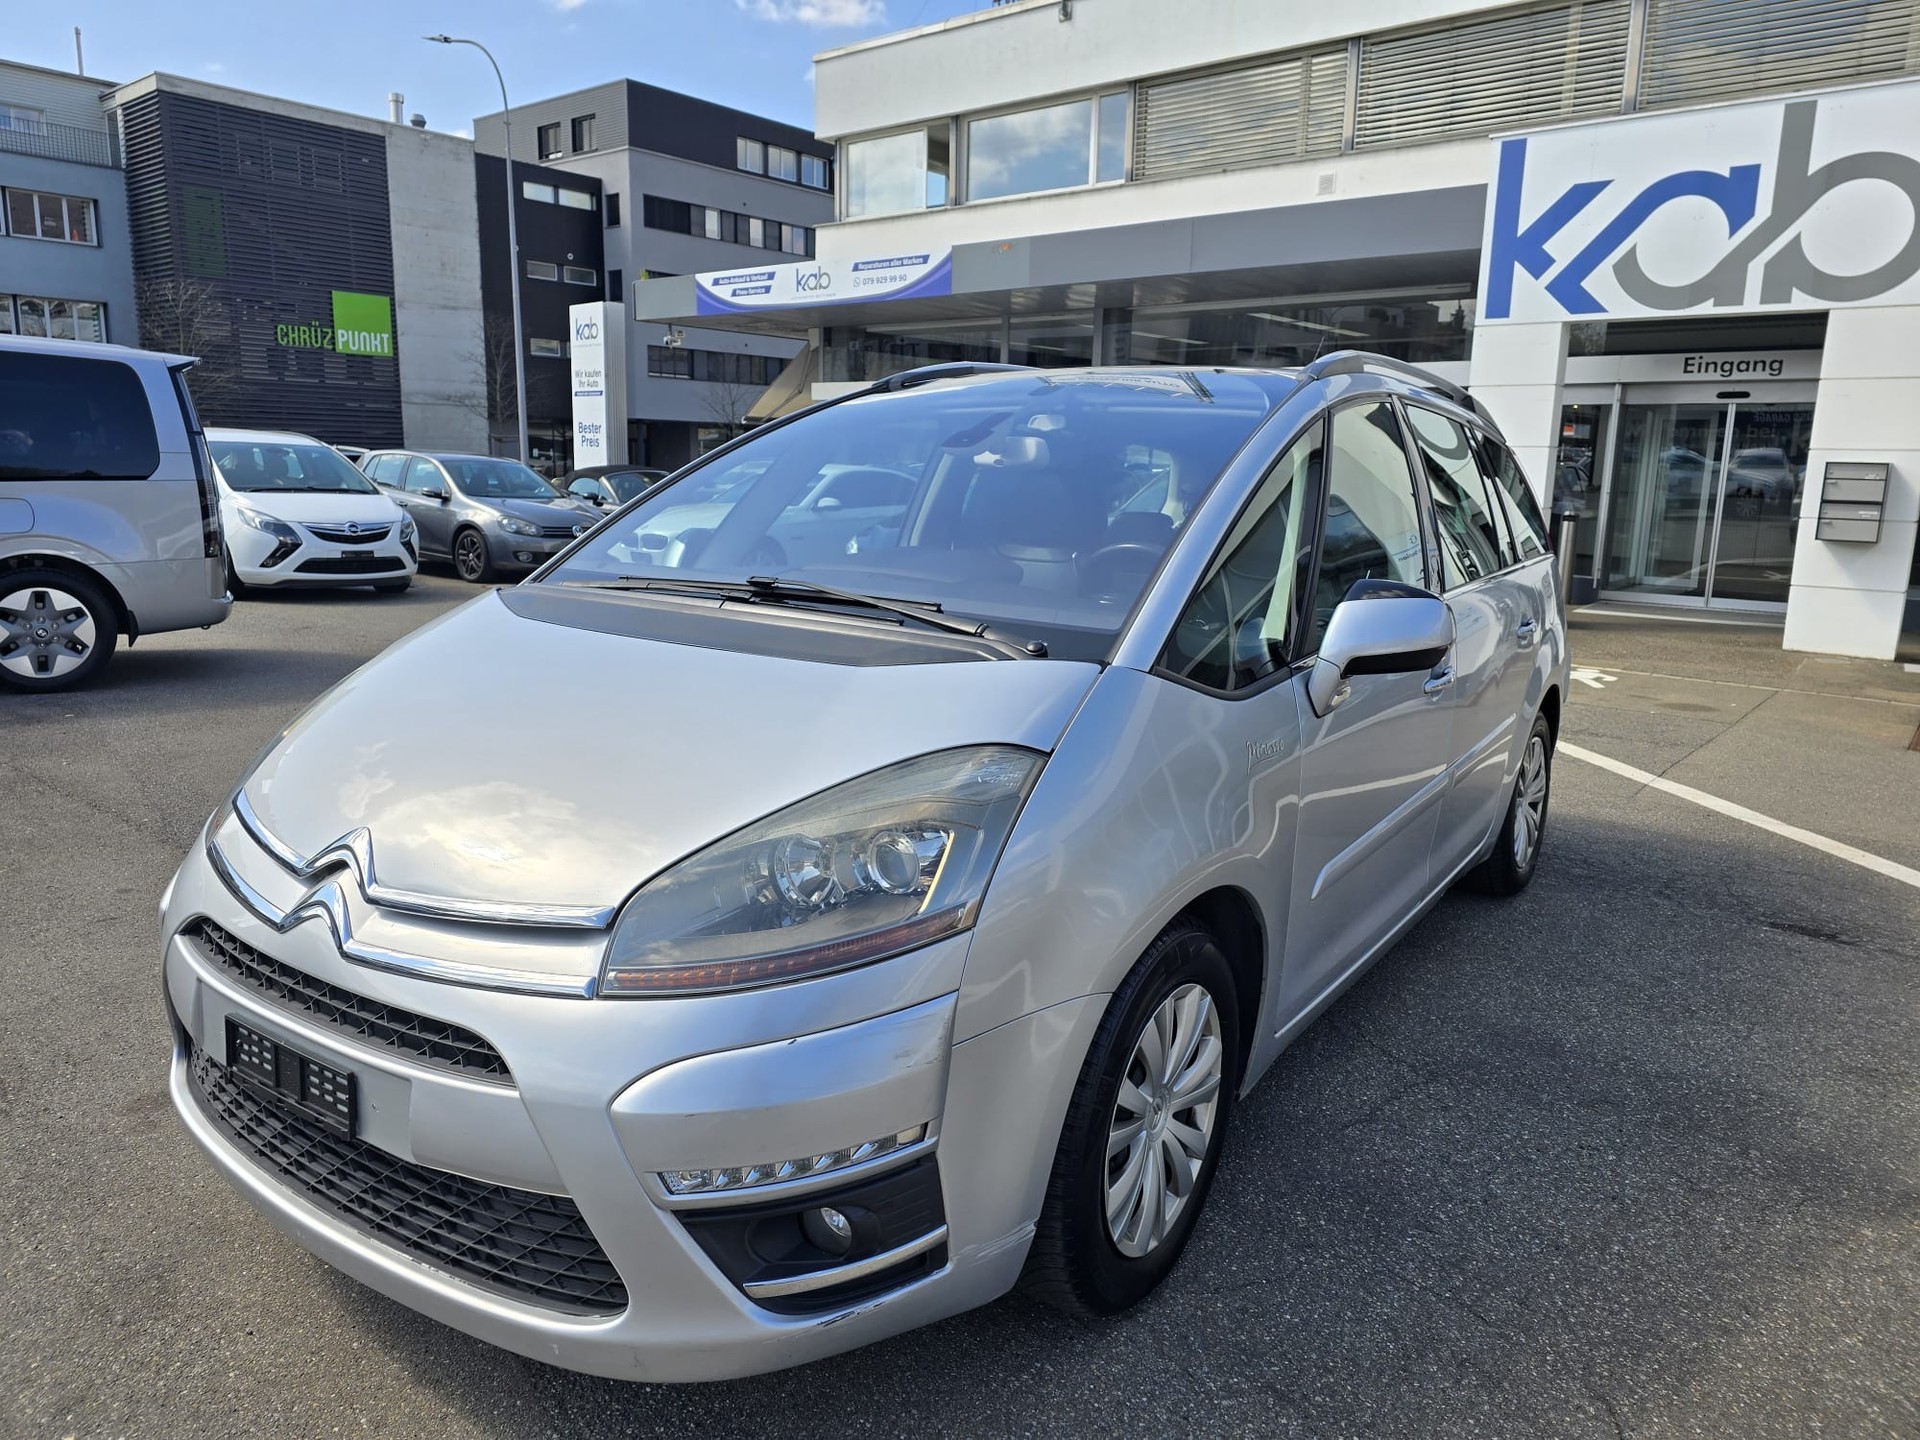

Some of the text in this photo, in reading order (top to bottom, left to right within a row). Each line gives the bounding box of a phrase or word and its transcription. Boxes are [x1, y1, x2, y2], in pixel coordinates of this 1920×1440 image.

[1485, 100, 1920, 311] kab
[903, 257, 924, 265] Marken
[796, 266, 831, 292] kab
[862, 277, 874, 285] 079
[876, 276, 887, 284] 929
[576, 316, 599, 341] kab
[277, 321, 389, 354] CHRÜZ PUNKT
[575, 369, 602, 378] Wir kaufen
[1683, 355, 1784, 378] Eingang
[587, 380, 599, 388] Auto
[578, 421, 602, 434] Bester
[581, 434, 600, 448] Preis
